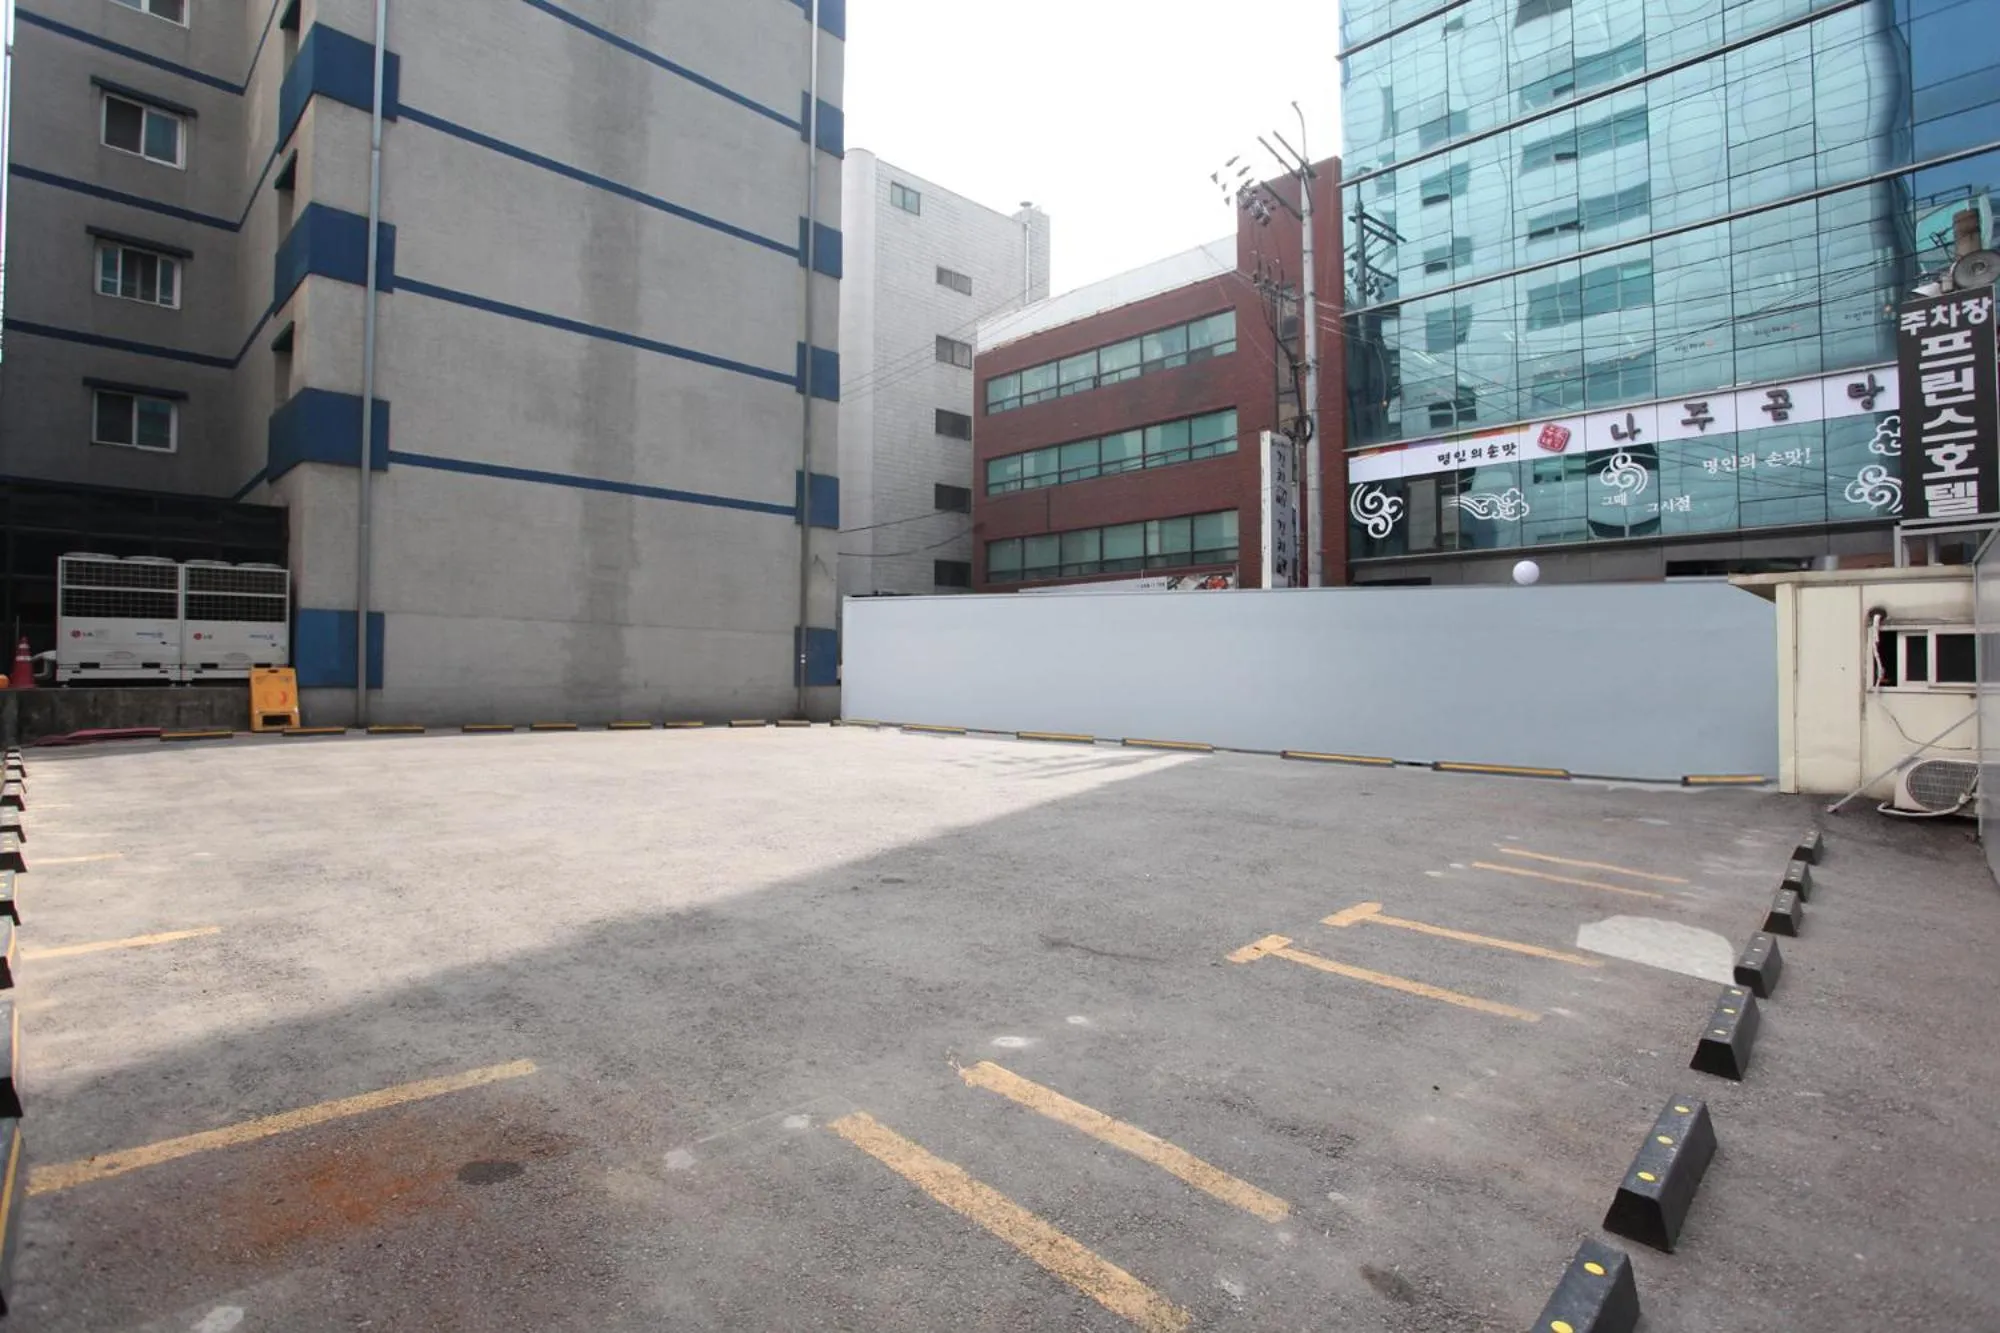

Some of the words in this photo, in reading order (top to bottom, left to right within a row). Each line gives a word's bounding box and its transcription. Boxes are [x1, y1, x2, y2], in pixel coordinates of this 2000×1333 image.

[1900, 297, 1992, 336] 주차장
[1610, 373, 1885, 441] 나주곰탕
[1919, 330, 1979, 518] 프린스호텔
[1703, 454, 1756, 474] 명인의
